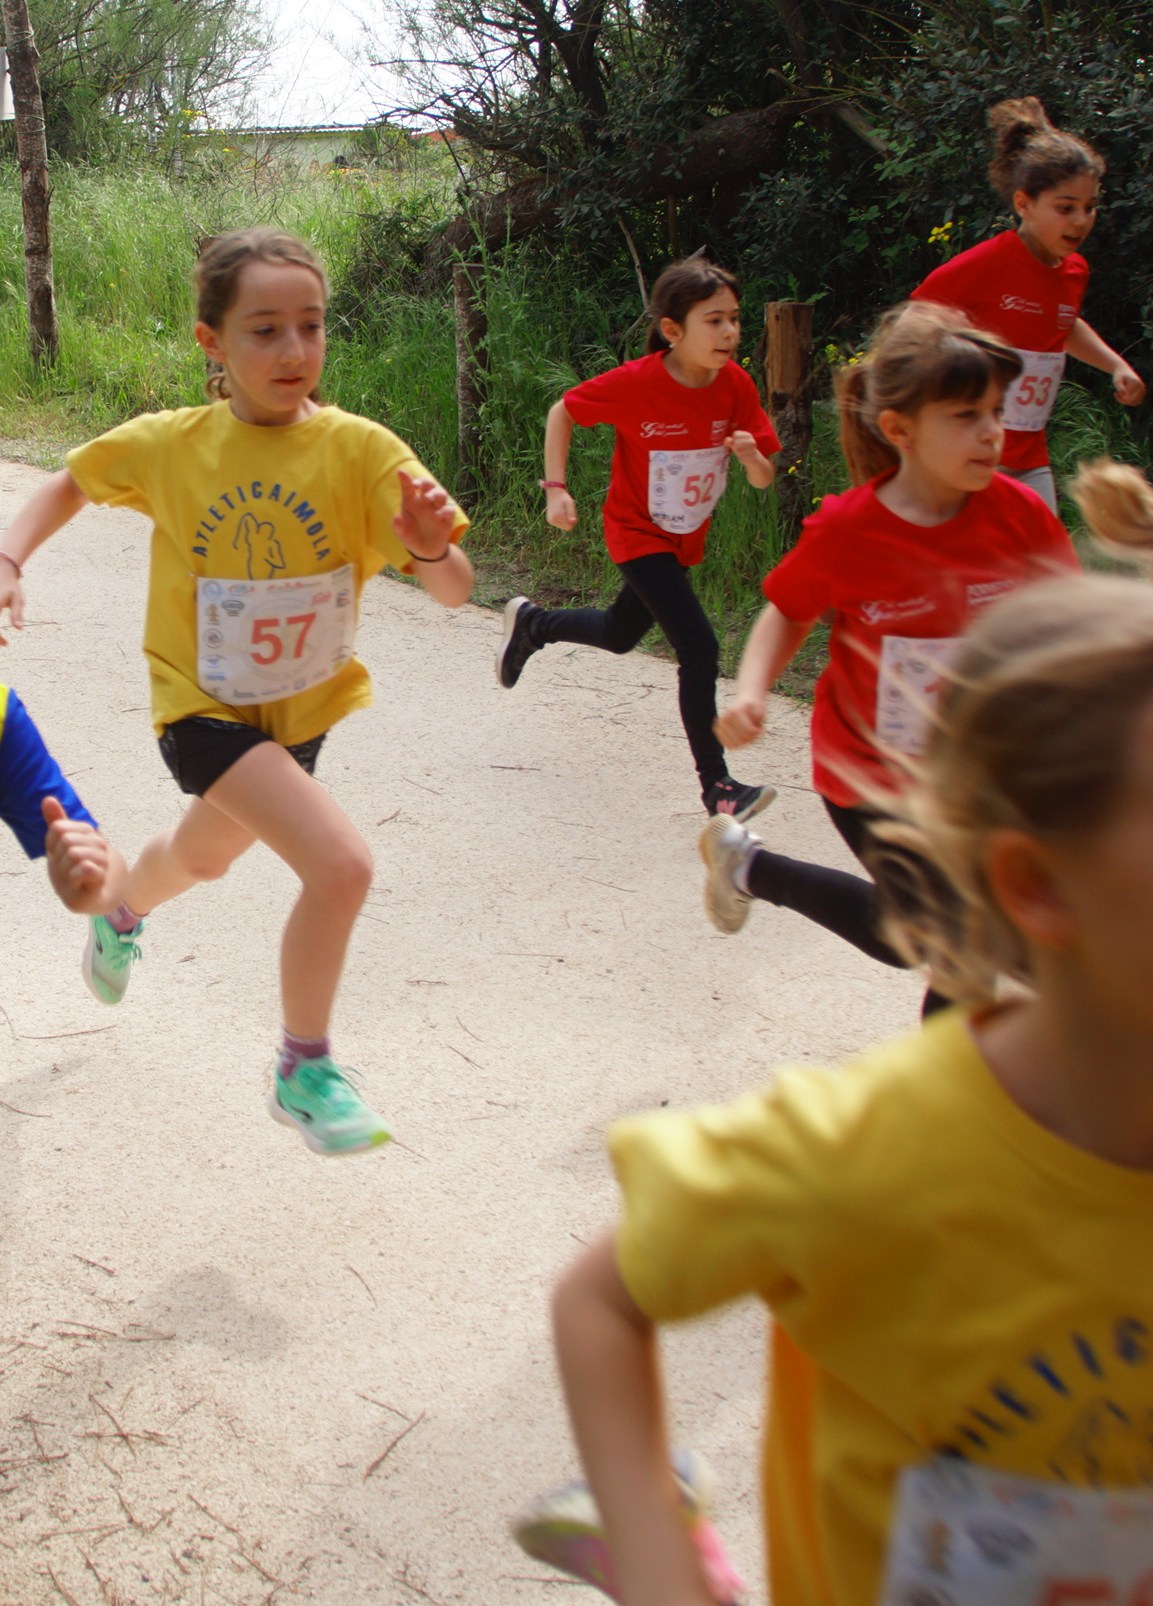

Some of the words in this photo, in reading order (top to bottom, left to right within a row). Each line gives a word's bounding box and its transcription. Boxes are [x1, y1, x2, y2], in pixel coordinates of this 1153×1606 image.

[1014, 375, 1053, 408] 53
[682, 471, 716, 508] 52
[249, 611, 318, 667] 57
